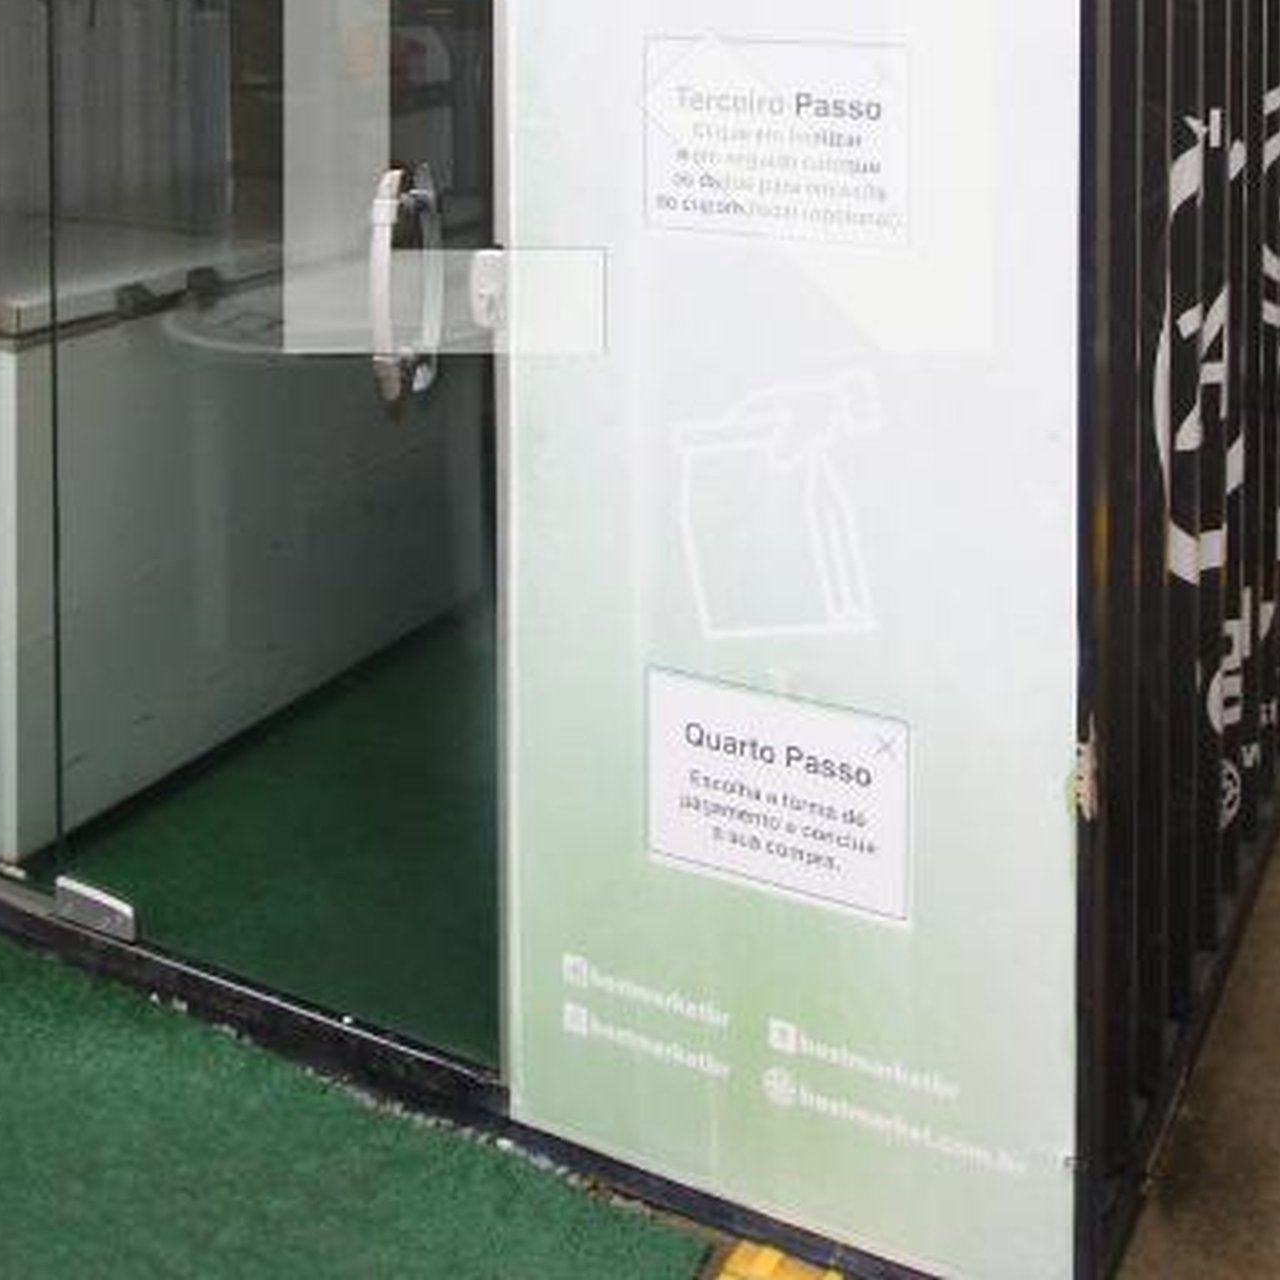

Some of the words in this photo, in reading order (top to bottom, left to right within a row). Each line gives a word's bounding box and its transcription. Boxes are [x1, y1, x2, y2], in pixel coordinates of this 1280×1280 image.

[793, 91, 883, 121] Passo
[683, 721, 777, 766] Quarto
[784, 744, 873, 788] Passo
[679, 794, 781, 832] pagamento
[689, 768, 762, 802] Escolha
[780, 791, 839, 822] forma
[841, 805, 868, 828] de
